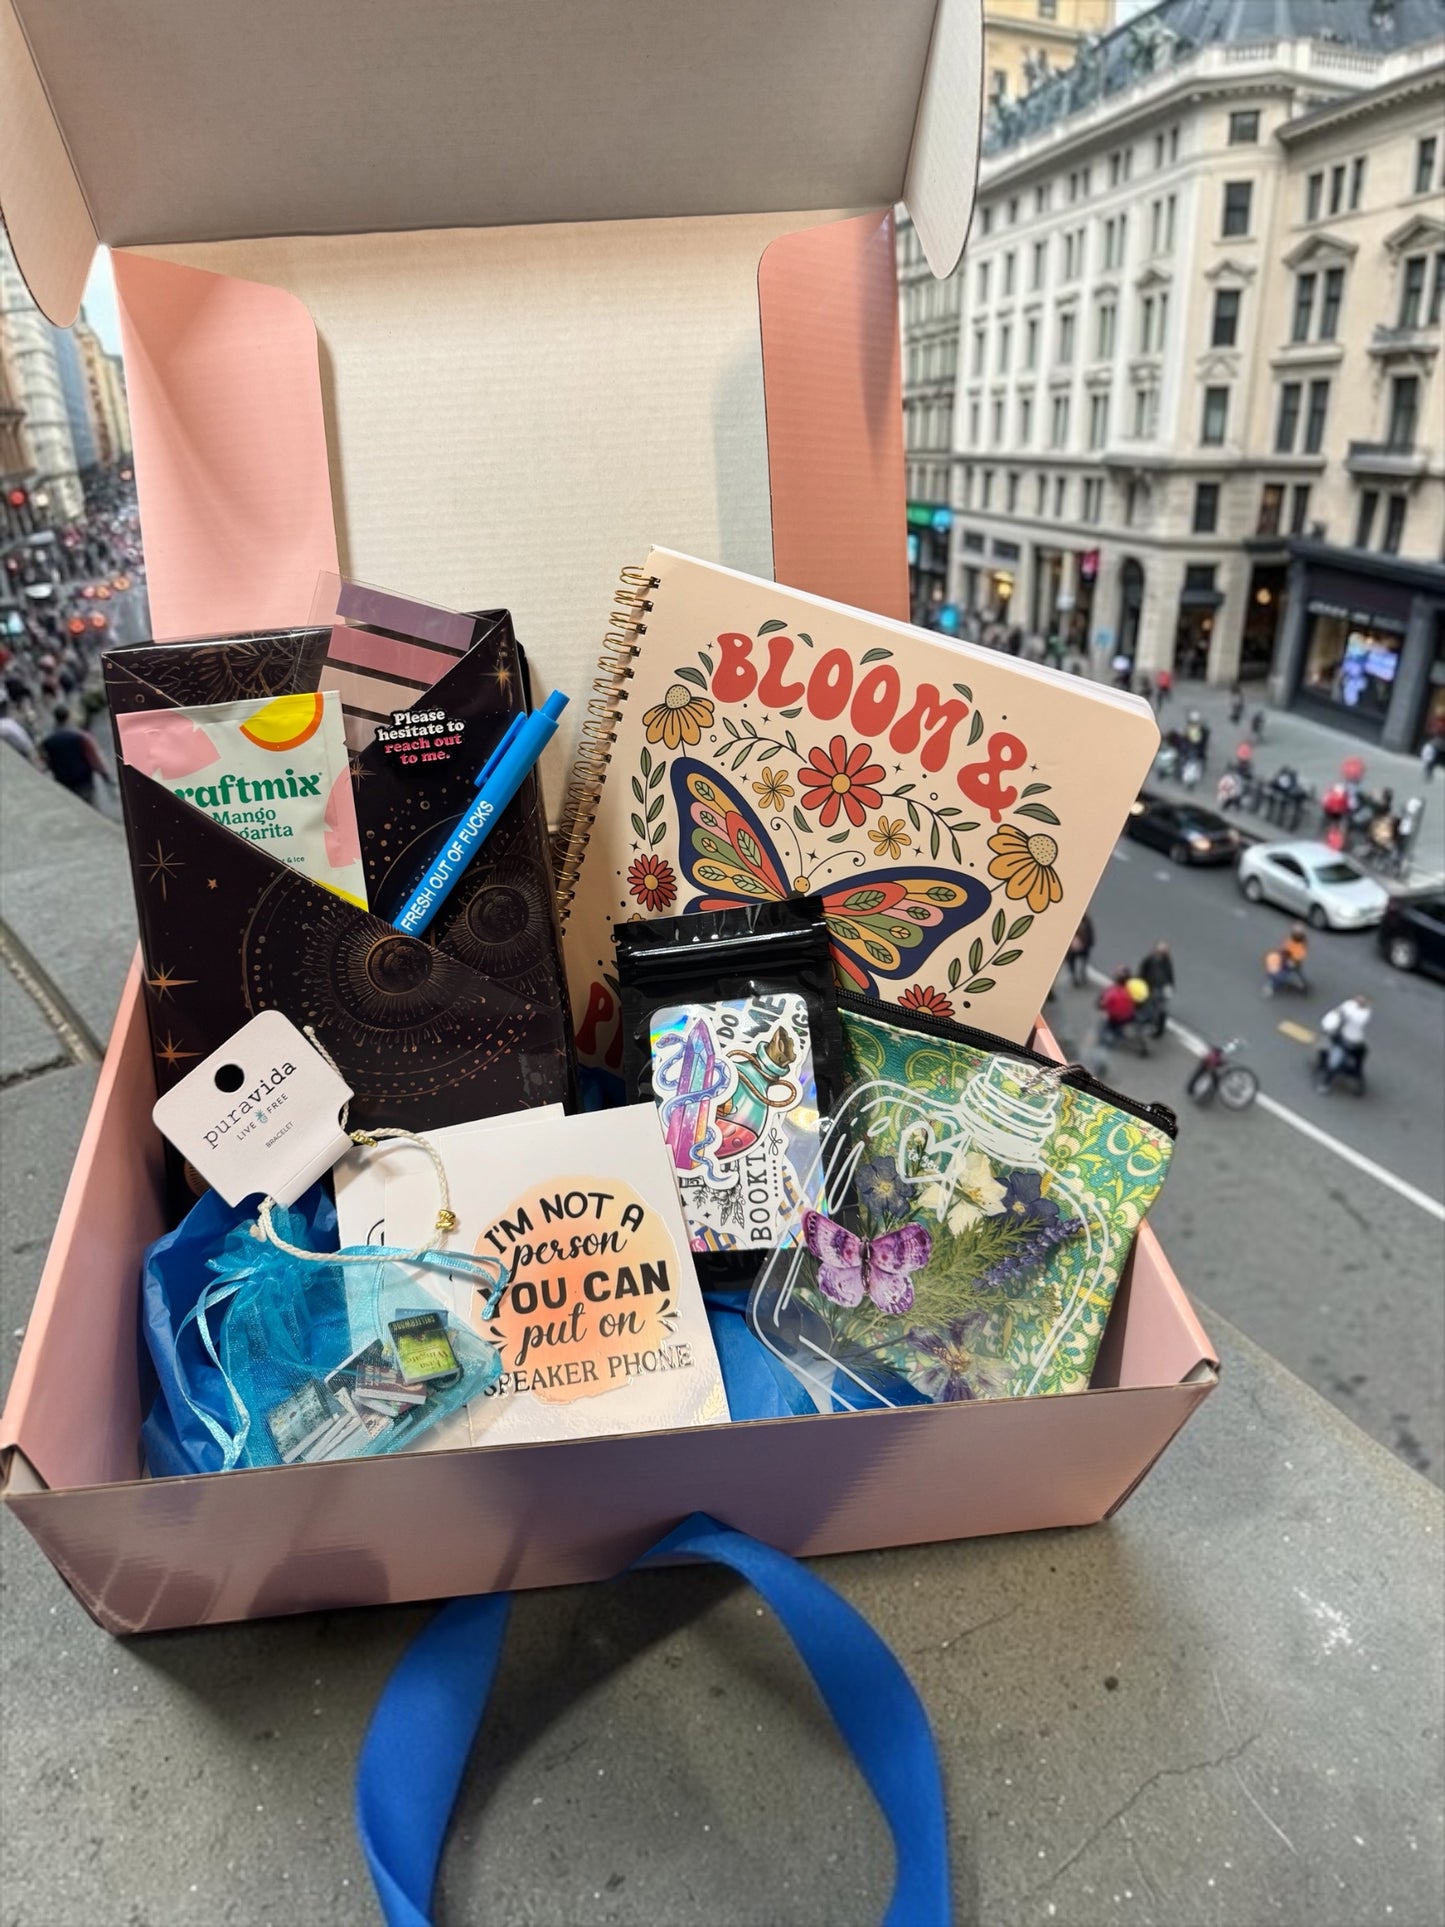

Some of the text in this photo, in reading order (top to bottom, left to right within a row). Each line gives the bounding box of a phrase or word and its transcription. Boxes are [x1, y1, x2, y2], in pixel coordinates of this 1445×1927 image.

[377, 720, 466, 742] hesitate to
[393, 710, 446, 726] Please
[711, 632, 1028, 824] BLOOM &
[384, 733, 463, 754] reach out
[400, 750, 451, 765] to me.
[174, 768, 322, 808] raftmix
[212, 807, 276, 826] Mango
[240, 823, 294, 840] garita
[400, 800, 495, 932] FRESH OUT OF FUCKS
[716, 1014, 739, 1040] DO
[236, 1092, 289, 1141] LIVE FREE
[265, 1120, 295, 1148] BRACELET
[746, 1142, 773, 1242] BOOKT
[484, 1191, 645, 1254] I'M NOT A
[508, 1230, 628, 1284] person
[477, 1260, 671, 1319] YOU CAN
[514, 1302, 646, 1367] put on
[483, 1343, 694, 1396] SPEAKER PHONE
